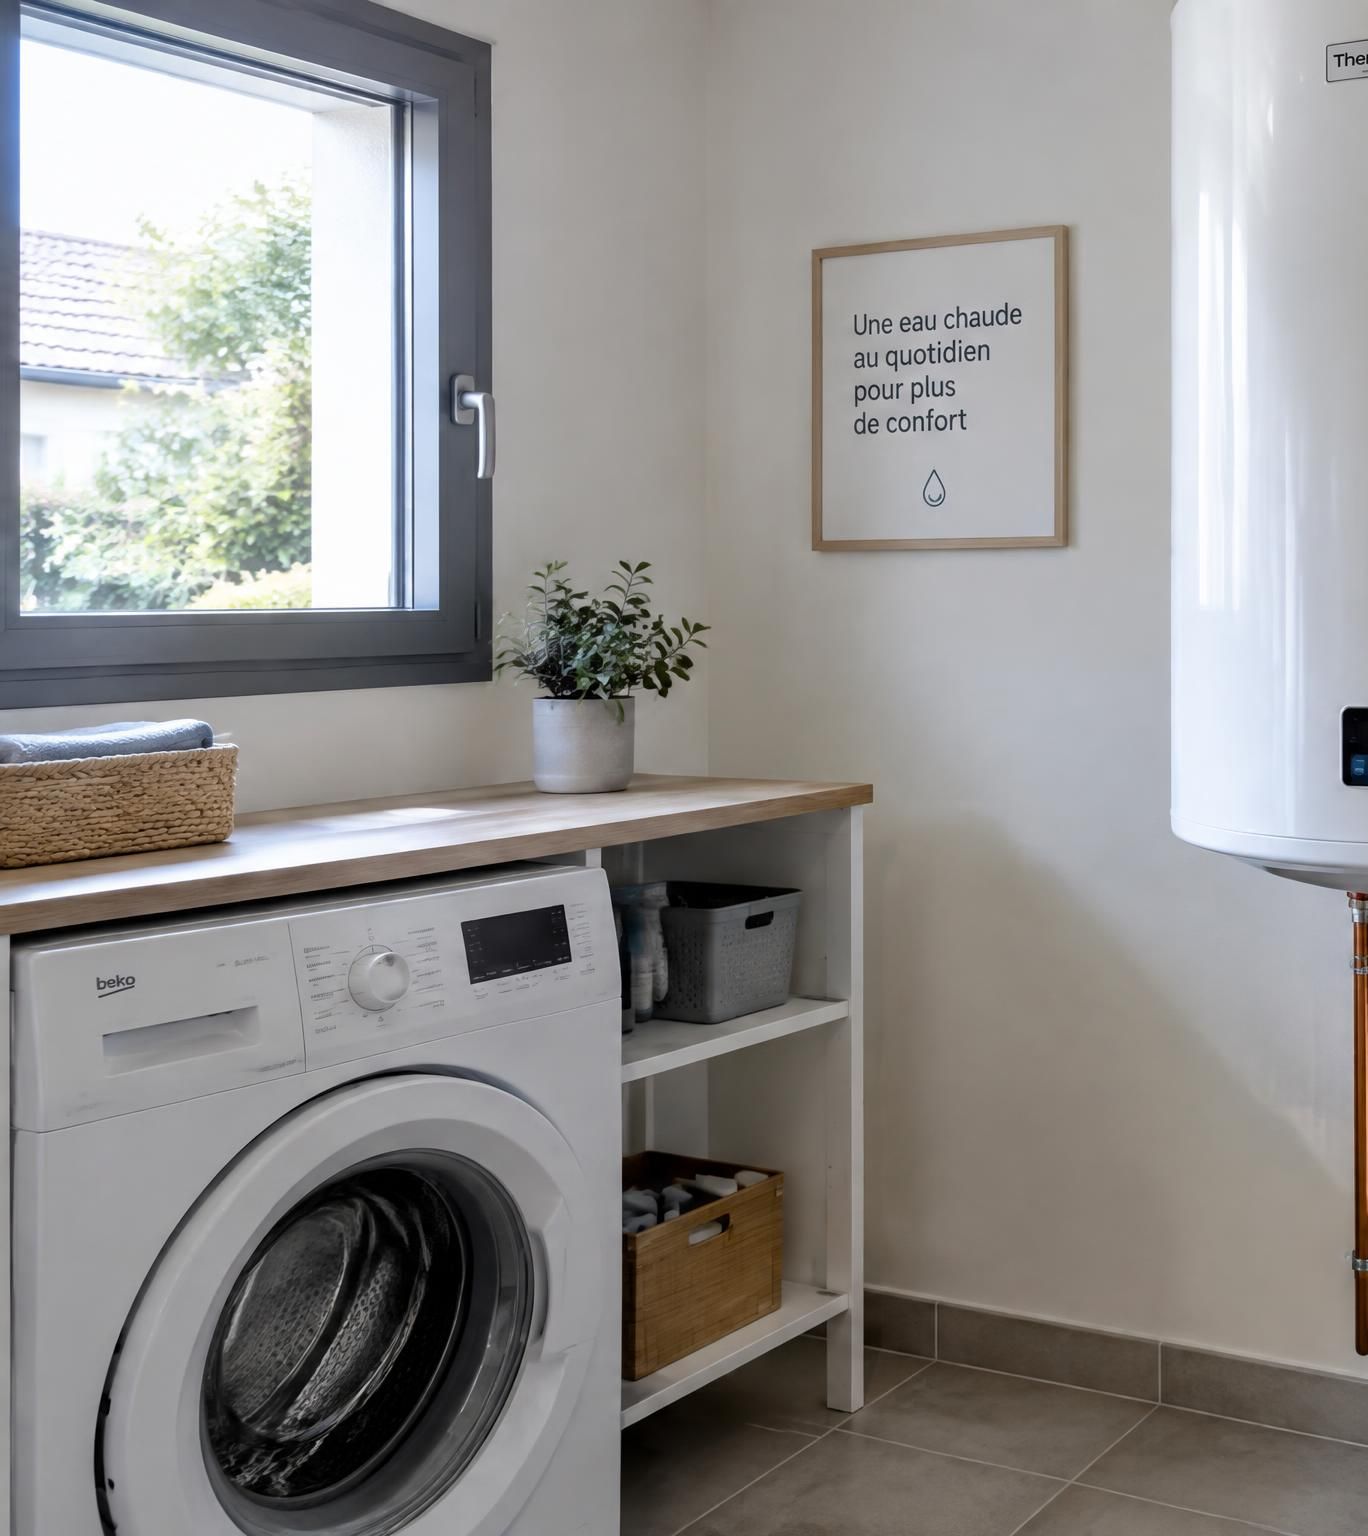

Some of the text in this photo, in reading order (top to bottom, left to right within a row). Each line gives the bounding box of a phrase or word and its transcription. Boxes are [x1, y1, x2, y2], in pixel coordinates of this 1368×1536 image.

[853, 302, 1023, 336] Une eau chaude
[853, 339, 991, 372] au quotidien
[854, 375, 956, 408] pour plus
[853, 408, 967, 435] de confort
[96, 974, 136, 991] beko
